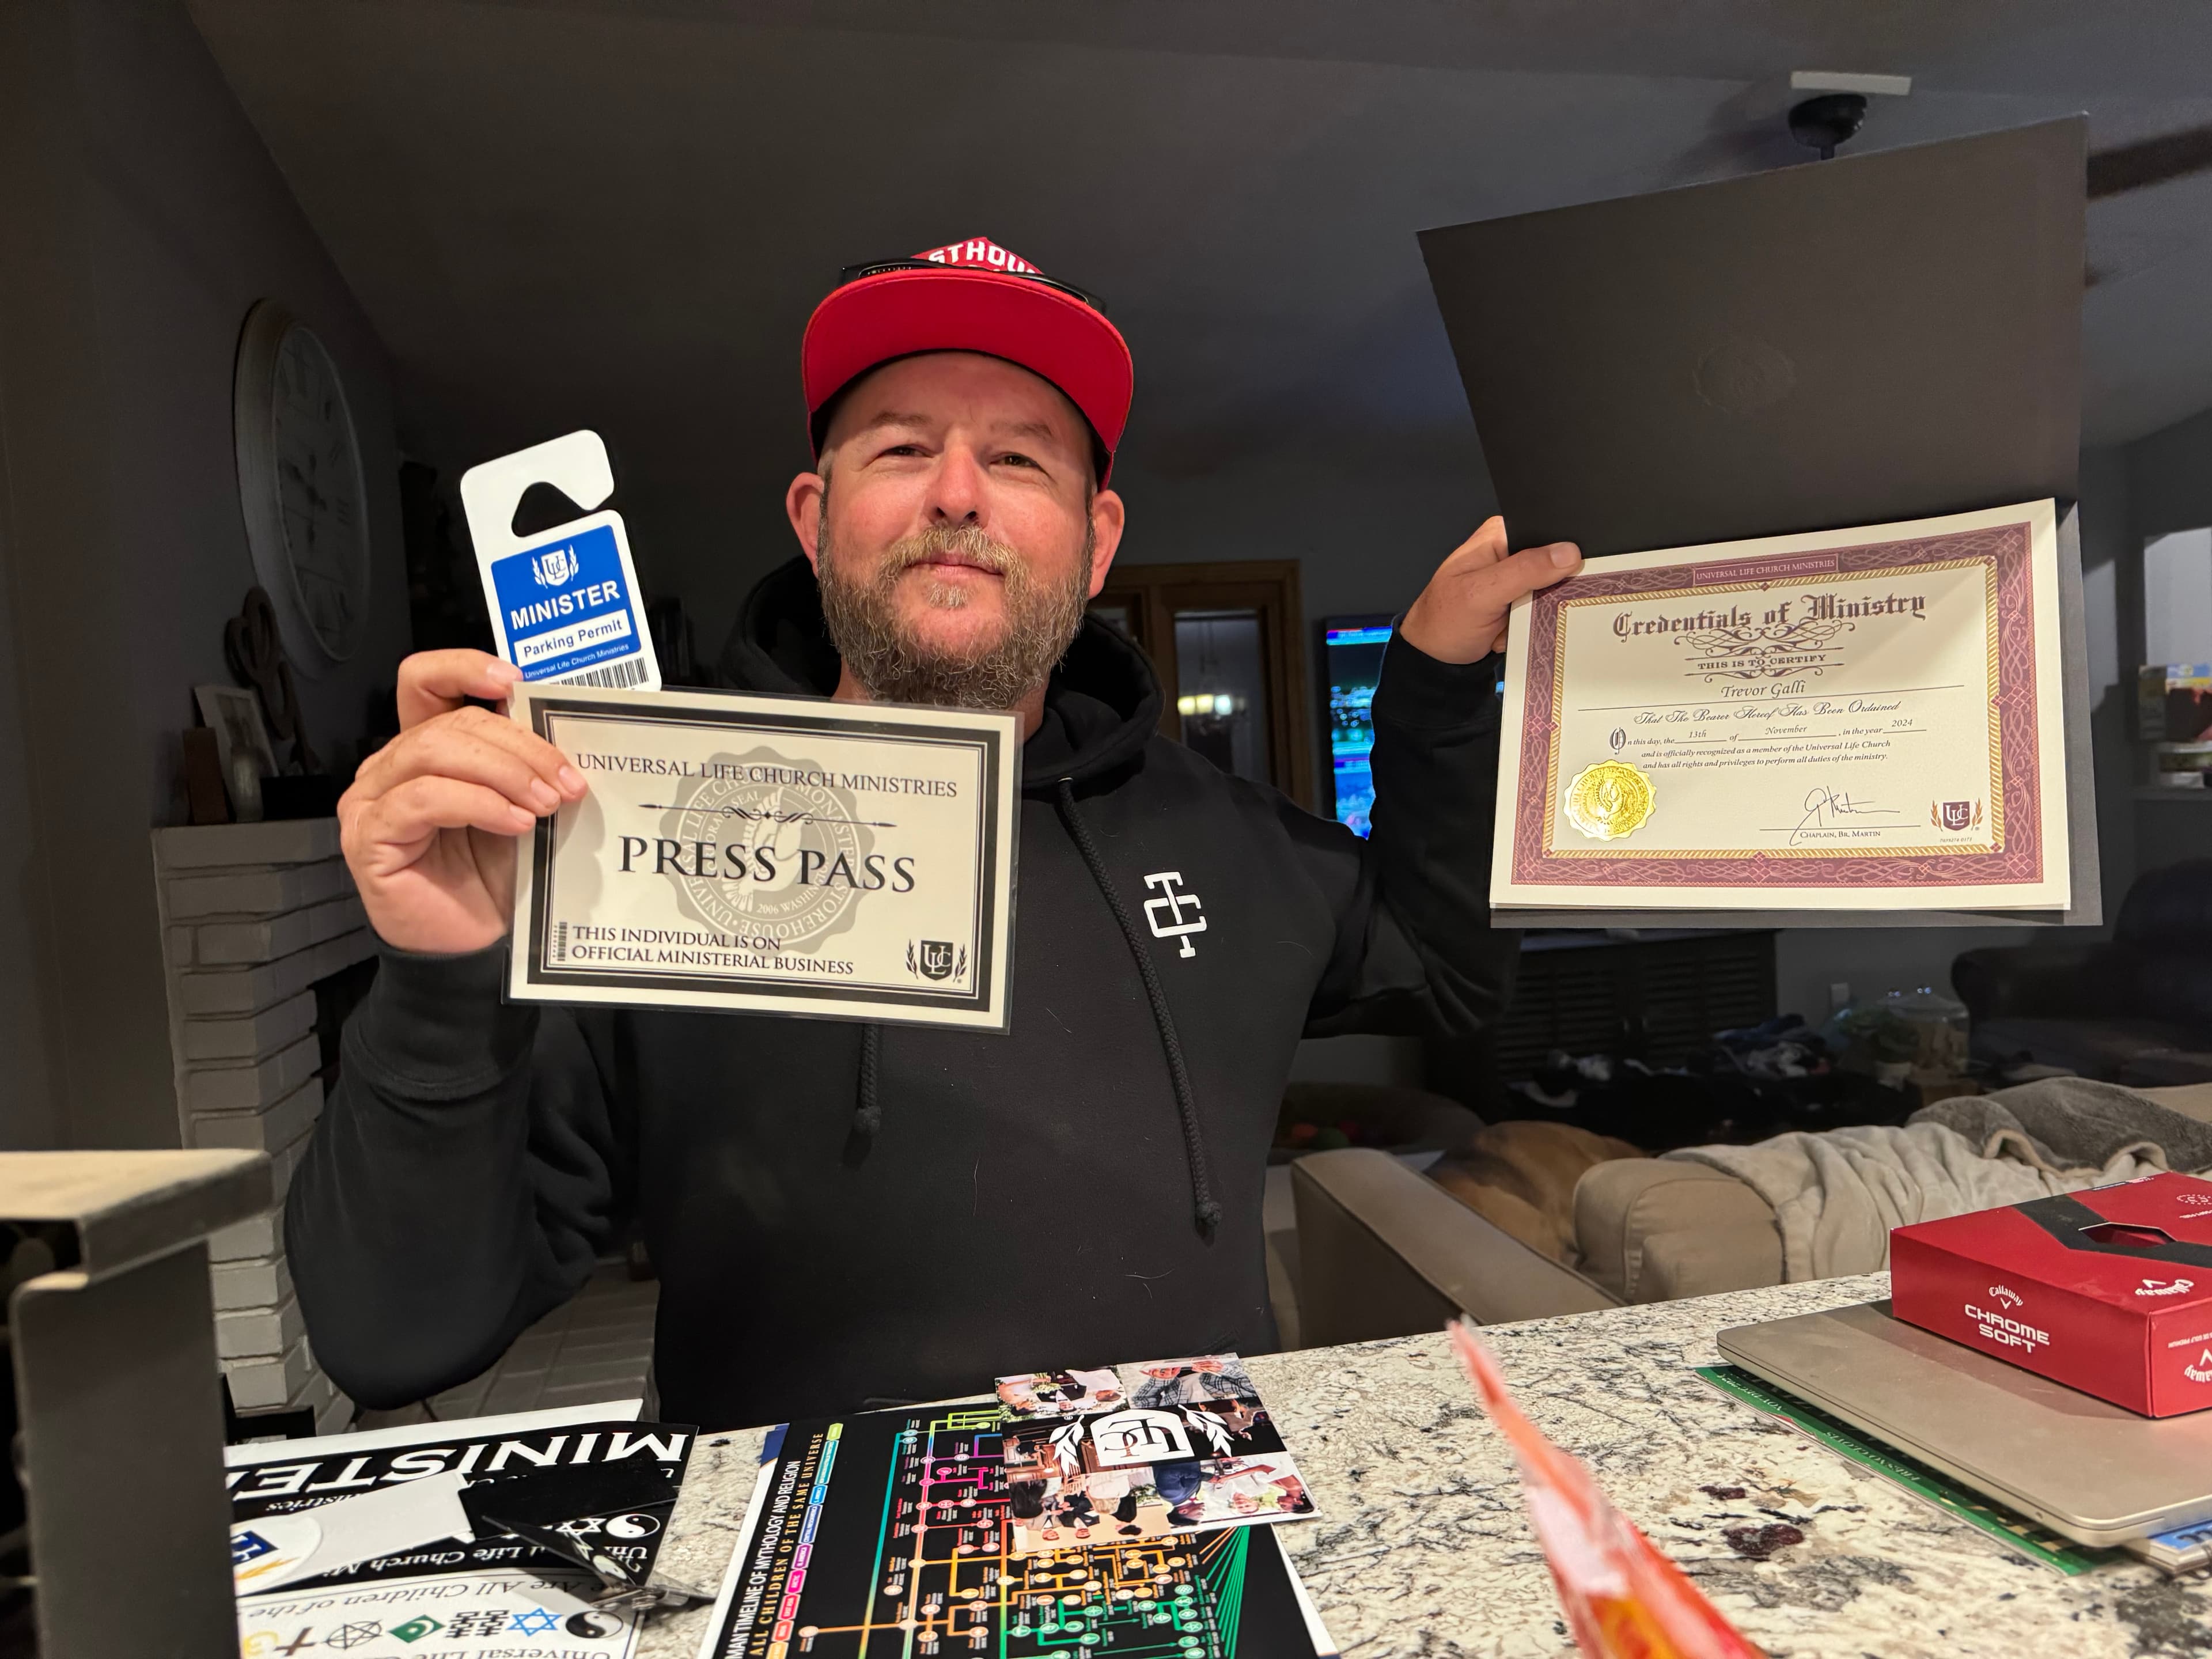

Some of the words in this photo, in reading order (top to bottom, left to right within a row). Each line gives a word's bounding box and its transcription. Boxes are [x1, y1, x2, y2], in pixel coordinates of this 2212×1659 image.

[1696, 569, 1737, 579] UNIVERSAL
[1740, 568, 1755, 576] LIFE
[1756, 564, 1790, 574] CHURCH
[1791, 560, 1835, 571] MINISTRIES
[510, 580, 620, 630] MINISTER
[1612, 604, 1752, 643] Credentials
[1762, 601, 1793, 625] of
[1801, 592, 1926, 620] Ministry
[524, 632, 574, 658] Parking
[578, 618, 623, 644] Permit
[525, 664, 556, 679] Universal
[557, 660, 570, 670] Life
[571, 653, 596, 665] Church
[597, 643, 630, 659] Ministries
[1698, 661, 1728, 669] THIS
[1748, 659, 1765, 667] TO
[1770, 654, 1827, 665] CERTIFY
[1721, 685, 1767, 698] Trevor
[1771, 680, 1806, 699] Galli
[1634, 712, 1663, 724] That
[1665, 710, 1689, 722] The
[1693, 709, 1729, 721] Bearer
[1734, 705, 1779, 720] Hereof
[1778, 703, 1808, 717] Has
[1813, 702, 1845, 715] Been
[1849, 699, 1901, 713] Ordained
[1647, 738, 1661, 746] day,
[1688, 729, 1706, 738] 13th
[1765, 725, 1807, 735] November
[1865, 728, 1883, 736] year
[1892, 719, 1912, 727] 2024
[1664, 749, 1695, 758] officially
[1696, 748, 1735, 757] recognized
[1805, 743, 1842, 751] Universal
[1844, 742, 1859, 750] Life
[1719, 759, 1755, 767] privileges
[1765, 757, 1795, 766] perform
[577, 753, 695, 777] UNIVERSAL
[700, 763, 744, 780] LIFE
[750, 767, 834, 787] CHURCH
[842, 774, 957, 797] MINISTRIES
[618, 836, 776, 881] PRESS
[797, 849, 915, 892] PASS
[757, 904, 779, 914] 2006
[573, 926, 616, 941] THIS
[622, 929, 730, 947] INDIVIDUAL
[734, 935, 748, 949] IS
[753, 937, 780, 950] ON
[572, 945, 653, 962] OFFICIAL
[657, 949, 770, 968] MINISTERIAL
[774, 956, 853, 974] BUSINESS
[1988, 1285, 2023, 1306] Callaway
[1965, 1304, 2050, 1345] CHROME
[1979, 1323, 2036, 1353] SOFT
[801, 1433, 824, 1478] UNIVERSE
[778, 1461, 801, 1494] RELIGION
[772, 1496, 790, 1513] AND
[793, 1483, 810, 1509] SAME
[785, 1514, 801, 1535] THE
[473, 1546, 524, 1560] Life
[753, 1516, 785, 1570] MYTHOLOGY
[779, 1539, 794, 1553] OF
[370, 1551, 465, 1571] Church
[476, 1581, 521, 1596] All
[531, 1581, 581, 1593] Are
[749, 1571, 767, 1585] OF
[344, 1584, 468, 1605] Children
[759, 1558, 789, 1624] CHILDREN
[249, 1604, 300, 1618] the
[300, 1599, 334, 1616] of
[733, 1586, 764, 1633] TIMELINE
[749, 1630, 769, 1656] ALL
